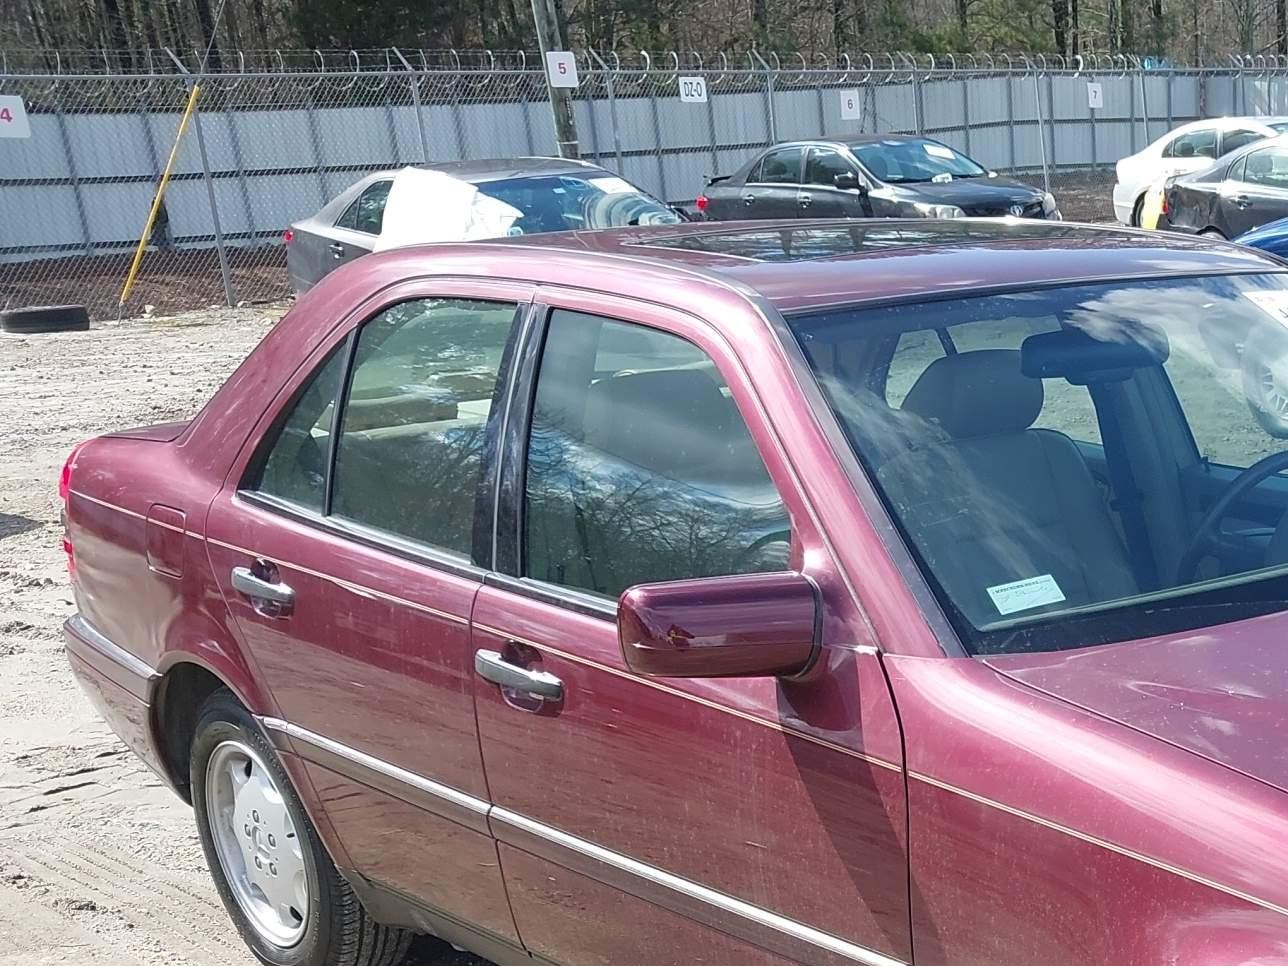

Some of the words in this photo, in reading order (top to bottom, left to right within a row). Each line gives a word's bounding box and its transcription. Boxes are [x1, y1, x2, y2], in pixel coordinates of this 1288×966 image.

[558, 62, 567, 75] 5
[1092, 89, 1098, 100] 7
[847, 98, 854, 110] 6
[0, 108, 13, 123] 4
